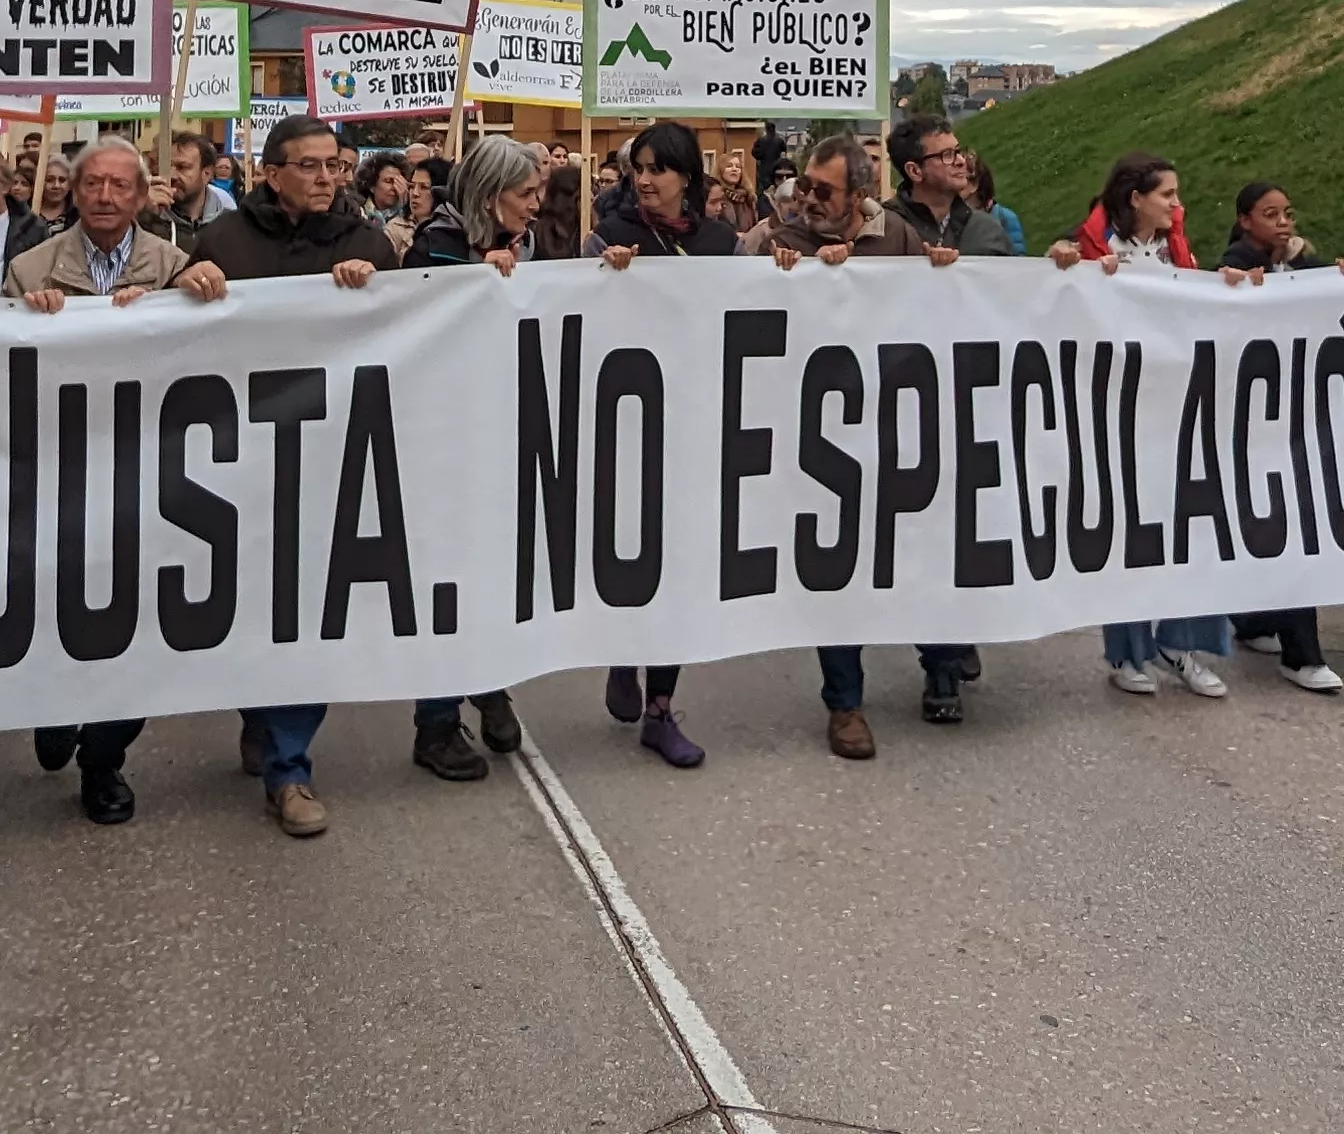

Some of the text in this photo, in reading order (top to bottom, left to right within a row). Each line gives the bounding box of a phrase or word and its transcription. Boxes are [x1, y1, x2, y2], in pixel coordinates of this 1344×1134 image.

[644, 4, 681, 17] POR EL
[683, 1, 735, 52] BIEN
[318, 40, 334, 56] LA
[338, 28, 436, 55] COMARCA
[500, 36, 583, 65] NO ES VER
[349, 56, 401, 73] DESTRUYE
[405, 55, 418, 68] SU
[809, 57, 867, 76] BIEN
[368, 69, 457, 96] SE DESTRUY
[628, 88, 683, 96] CORDILLERA
[773, 78, 868, 102] QUIEN?
[384, 99, 391, 110] A
[408, 94, 444, 108] MISMA
[515, 313, 665, 625] NO
